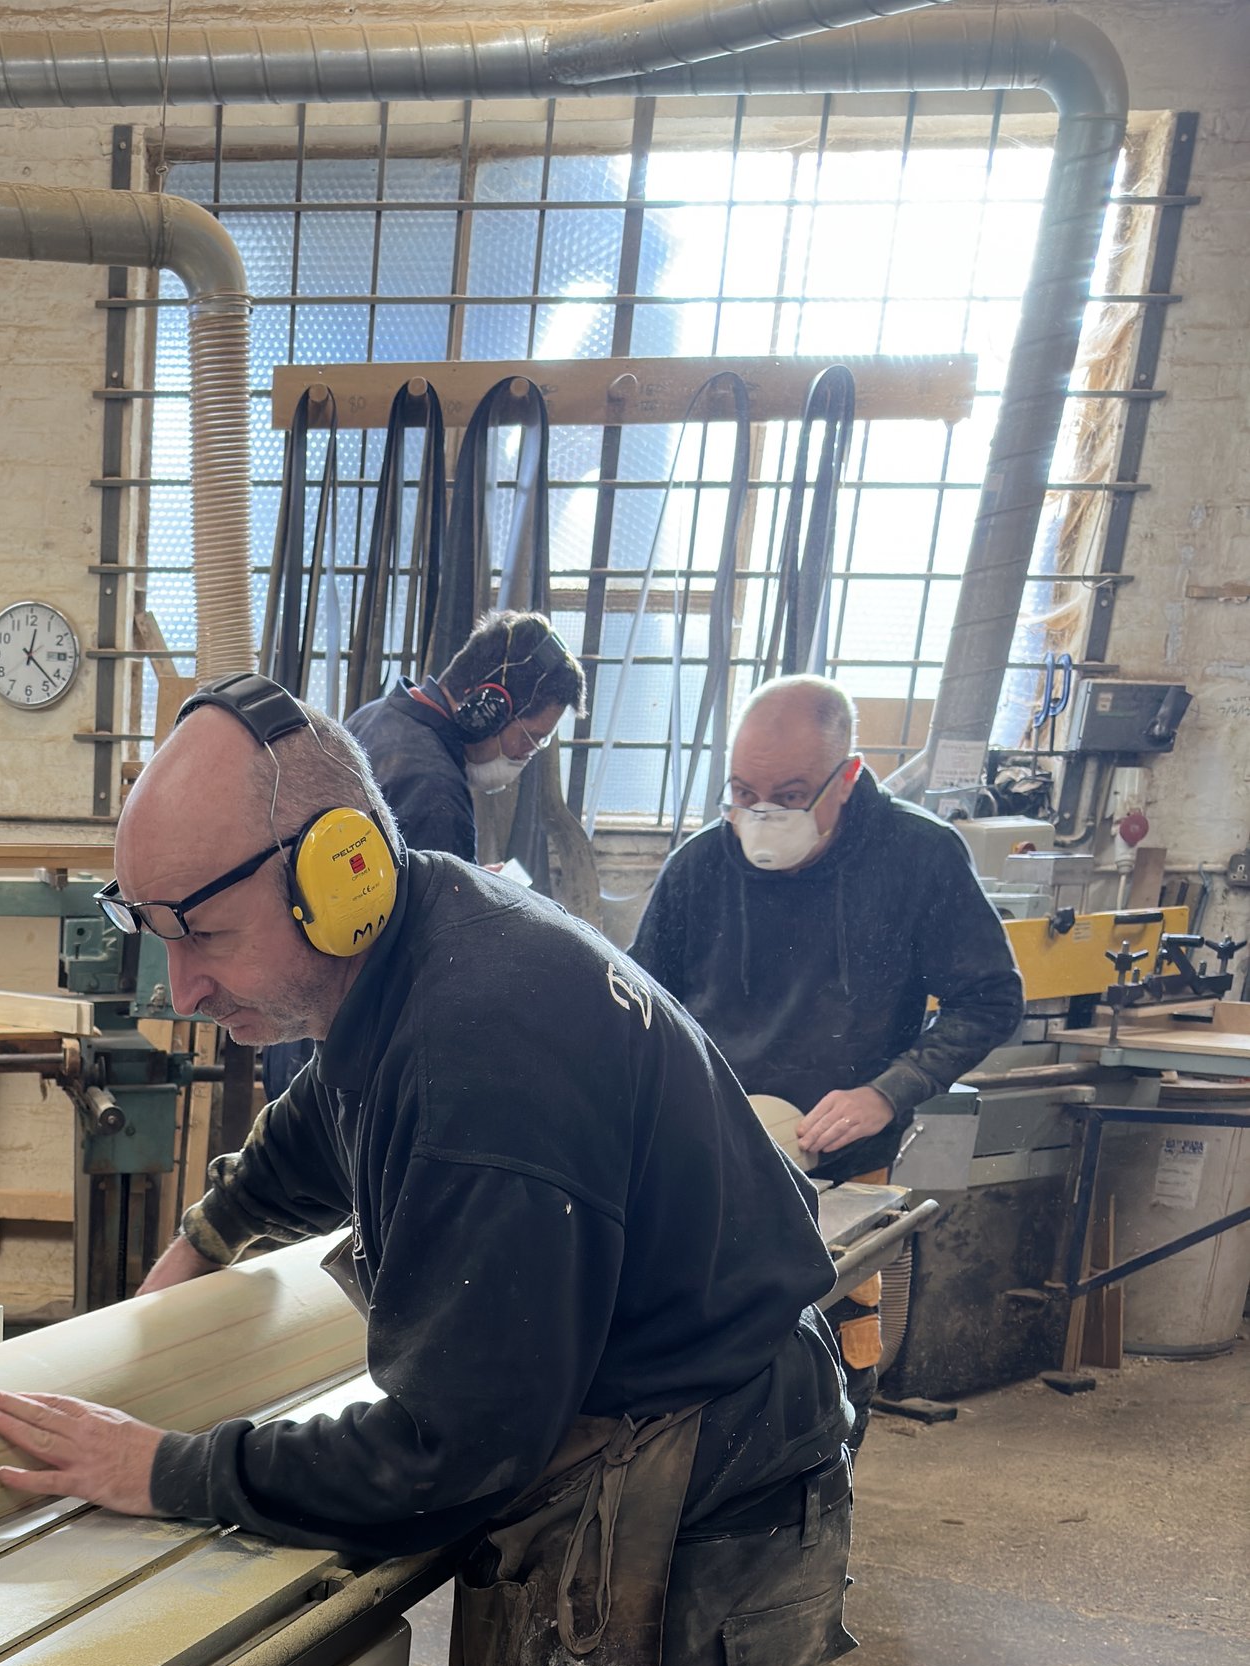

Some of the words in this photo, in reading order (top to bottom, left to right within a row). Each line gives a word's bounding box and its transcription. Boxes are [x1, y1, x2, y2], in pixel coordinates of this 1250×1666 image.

[11, 619, 21, 632] 11
[26, 614, 38, 627] 12
[55, 635, 64, 647] 2
[53, 668, 61, 680] 4
[8, 679, 16, 691] 7
[25, 685, 33, 697] 6
[41, 681, 50, 692] 5
[332, 836, 367, 861] PELTOR
